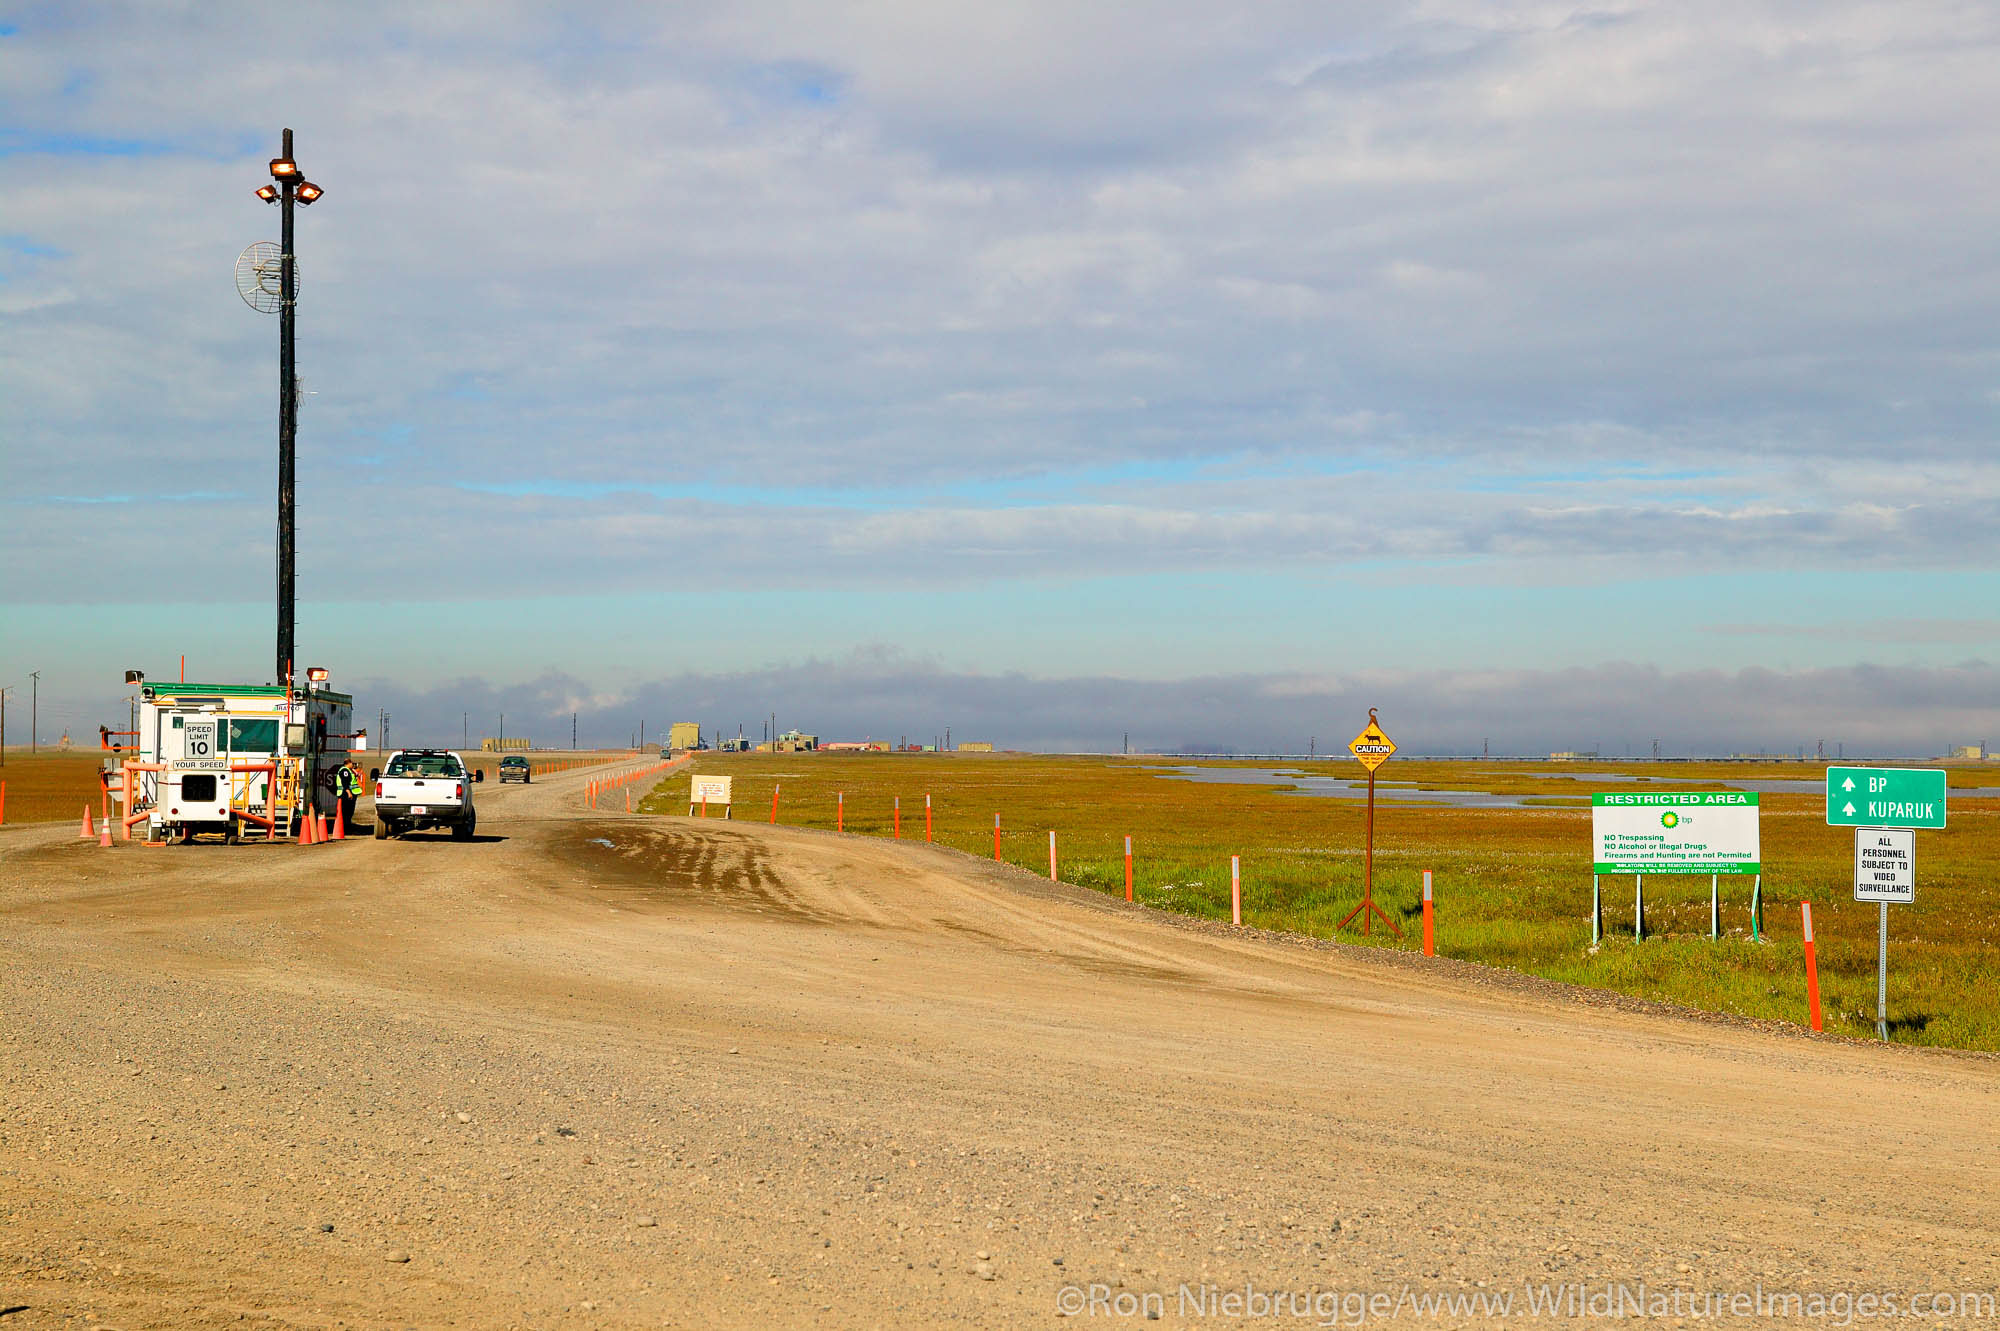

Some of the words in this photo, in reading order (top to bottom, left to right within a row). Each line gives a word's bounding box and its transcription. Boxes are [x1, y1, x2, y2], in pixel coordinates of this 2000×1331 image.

[191, 741, 208, 755] 10
[1356, 745, 1390, 753] CAUTION
[1868, 776, 1888, 793] BP
[1604, 795, 1701, 804] RESTRICTED
[1705, 795, 1747, 804] AREA
[1868, 801, 1934, 819] KUPARUK
[1681, 816, 1693, 824] bp
[1618, 834, 1665, 842] Trespassing
[1878, 837, 1892, 847] ALL
[1659, 843, 1682, 851] Illegal
[1684, 843, 1708, 851] Drugs
[1656, 852, 1686, 860] Hunting
[1862, 849, 1907, 858] PERSONNEL
[1861, 860, 1896, 870] SUBJECT
[1898, 861, 1908, 870] TO
[1873, 872, 1896, 882] VIDEO
[1858, 883, 1910, 894] SURVEILLANCE
